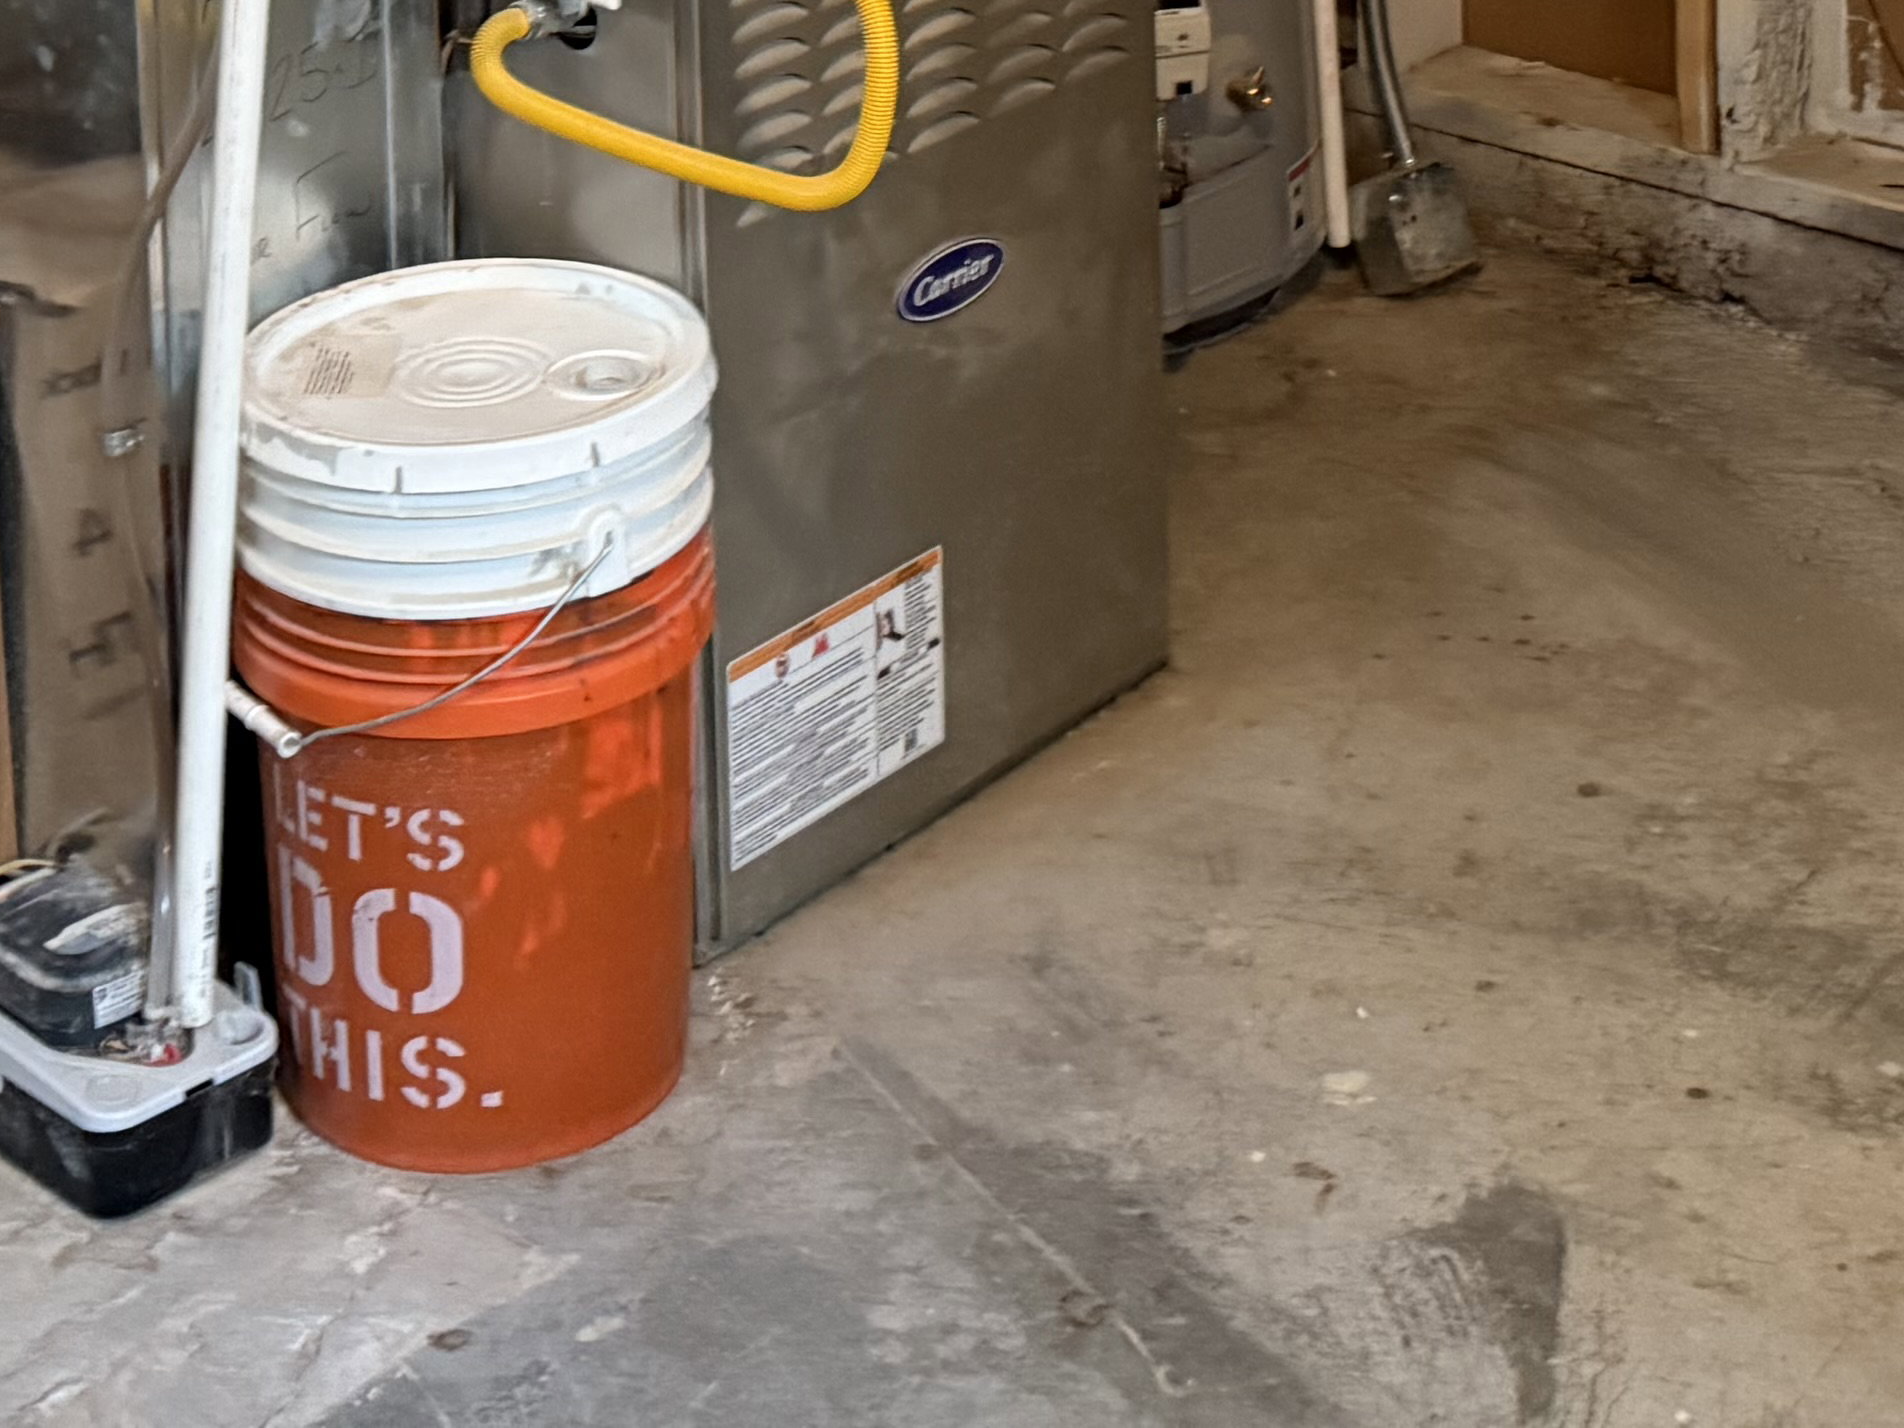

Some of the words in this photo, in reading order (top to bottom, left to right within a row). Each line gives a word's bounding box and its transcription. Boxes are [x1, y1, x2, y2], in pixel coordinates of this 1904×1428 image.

[913, 253, 995, 307] Carrier
[273, 761, 465, 872] LET'S
[277, 842, 464, 1015] DO
[283, 982, 505, 1111] THIS.
